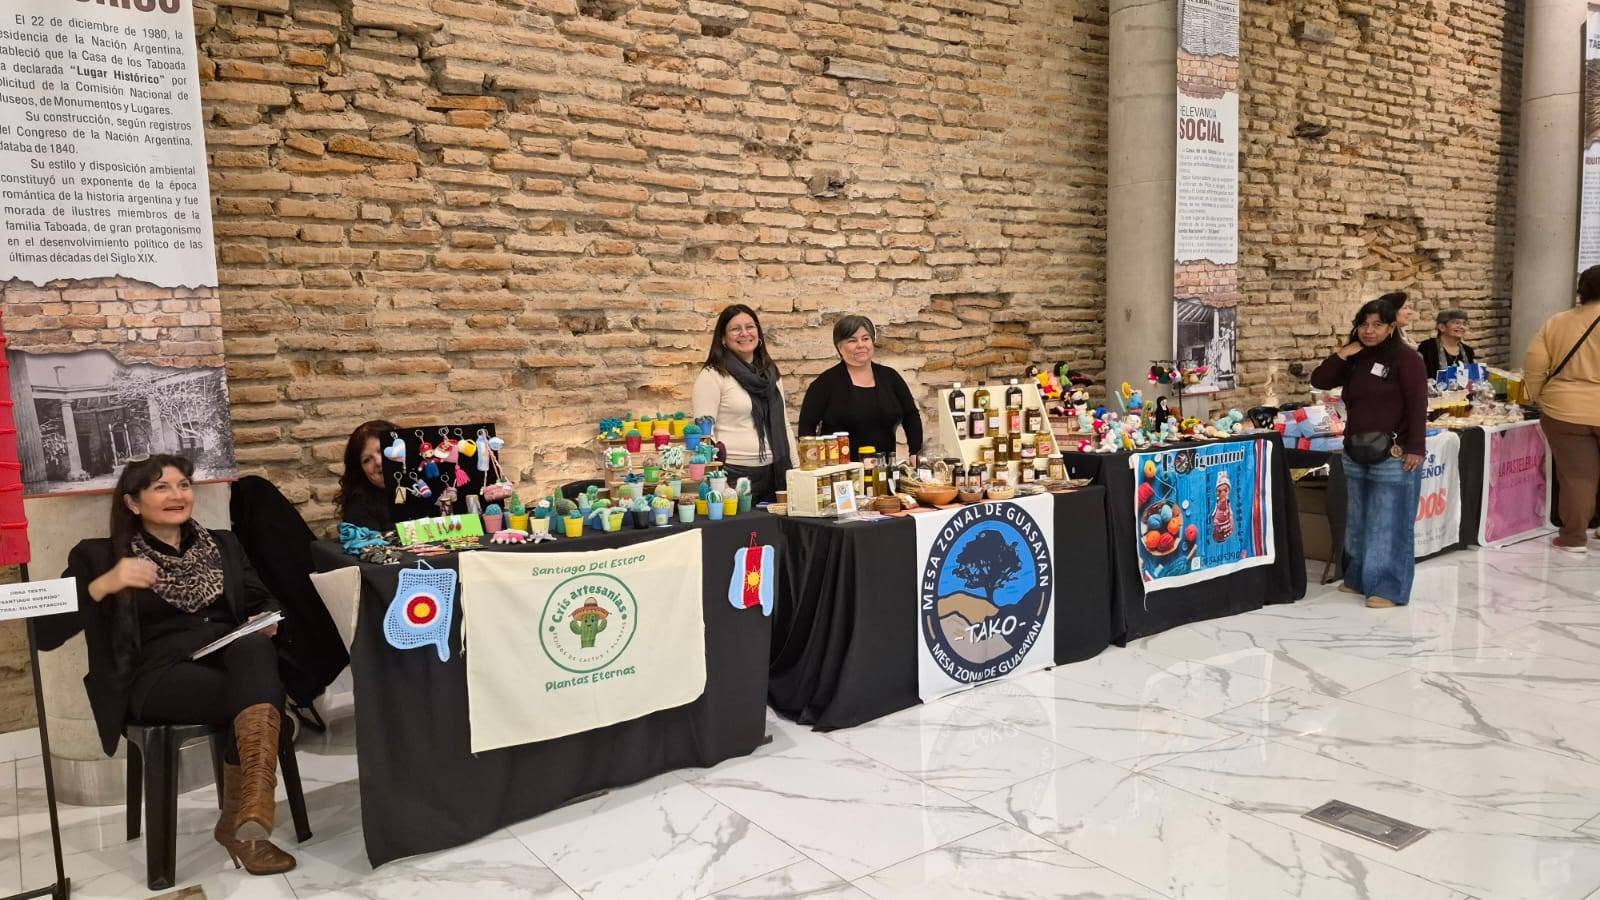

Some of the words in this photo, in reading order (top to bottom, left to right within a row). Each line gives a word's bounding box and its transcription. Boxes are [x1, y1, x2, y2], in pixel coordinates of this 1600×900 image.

[15, 15, 25, 24] El
[31, 16, 44, 26] 22
[50, 16, 62, 26] de
[69, 18, 119, 33] diciembre
[125, 25, 136, 36] de
[143, 28, 170, 40] 1980,
[175, 30, 183, 39] la
[56, 32, 68, 43] de
[76, 34, 84, 44] la
[92, 36, 127, 50] Nación
[134, 42, 184, 55] Argentina,
[45, 51, 64, 60] que
[69, 50, 77, 59] la
[82, 51, 107, 63] Casa
[111, 55, 123, 64] de
[127, 57, 141, 67] los
[147, 58, 186, 70] Taboada
[13, 62, 63, 74] declarada
[172, 76, 186, 86] por
[42, 80, 54, 90] de
[61, 80, 69, 90] la
[76, 81, 123, 96] Comisión
[130, 87, 171, 99] Nacional
[177, 92, 188, 101] de
[0, 93, 37, 107] useos,
[40, 96, 52, 105] de
[54, 96, 121, 111] Monumentos
[124, 103, 129, 113] y
[131, 103, 173, 116] Lugares.
[25, 111, 40, 121] Su
[43, 113, 113, 126] construcción,
[117, 119, 146, 129] según
[150, 120, 191, 131] registros
[1180, 118, 1224, 143] SOCIAL
[17, 126, 67, 140] Congreso
[73, 129, 85, 139] de
[91, 130, 100, 140] la
[105, 132, 139, 143] Nación
[35, 144, 47, 153] de
[50, 144, 78, 154] 1840.
[31, 159, 44, 169] Su
[49, 160, 76, 170] estilo
[80, 162, 85, 171] y
[90, 161, 146, 173] disposición
[150, 166, 195, 175] ambiental
[1, 174, 55, 187] constituyó
[62, 177, 74, 185] un
[81, 177, 133, 188] exponente
[139, 179, 150, 188] de
[156, 180, 163, 189] la
[169, 181, 196, 192] época
[3, 190, 55, 200] romántica
[59, 191, 70, 200] de
[74, 191, 83, 200] la
[86, 191, 124, 202] historia
[128, 194, 172, 206] argentina
[176, 198, 180, 206] y
[184, 196, 199, 204] fue
[4, 206, 45, 215] morada
[53, 206, 64, 216] de
[72, 207, 110, 216] ilustres
[118, 209, 167, 219] miembros
[174, 210, 186, 219] de
[192, 211, 200, 219] la
[6, 221, 41, 231] familia
[44, 222, 90, 232] Taboada,
[94, 222, 106, 231] de
[110, 224, 132, 234] gran
[136, 224, 201, 235] protagonismo
[8, 238, 19, 246] en
[26, 237, 34, 246] el
[40, 237, 129, 248] desenvolvimiento
[134, 239, 168, 250] político
[174, 239, 185, 249] de
[190, 240, 203, 249] las
[9, 253, 47, 262] últimas
[50, 253, 91, 262] décadas
[94, 253, 108, 262] del
[111, 254, 135, 264] Siglo
[138, 254, 157, 263] XIX.
[532, 564, 586, 576] Santiago
[589, 561, 607, 571] Del
[610, 554, 646, 568] Estero
[923, 556, 940, 610] MESA
[937, 507, 981, 551] ZONAL
[985, 503, 1002, 516] DE
[1006, 507, 1048, 587] GUASAYAN
[552, 598, 571, 623] Cris
[933, 643, 953, 674] MESA
[984, 666, 997, 679] DE
[999, 620, 1042, 673] GUASAYAN
[545, 675, 589, 692] Plantas
[592, 665, 636, 683] Eternas
